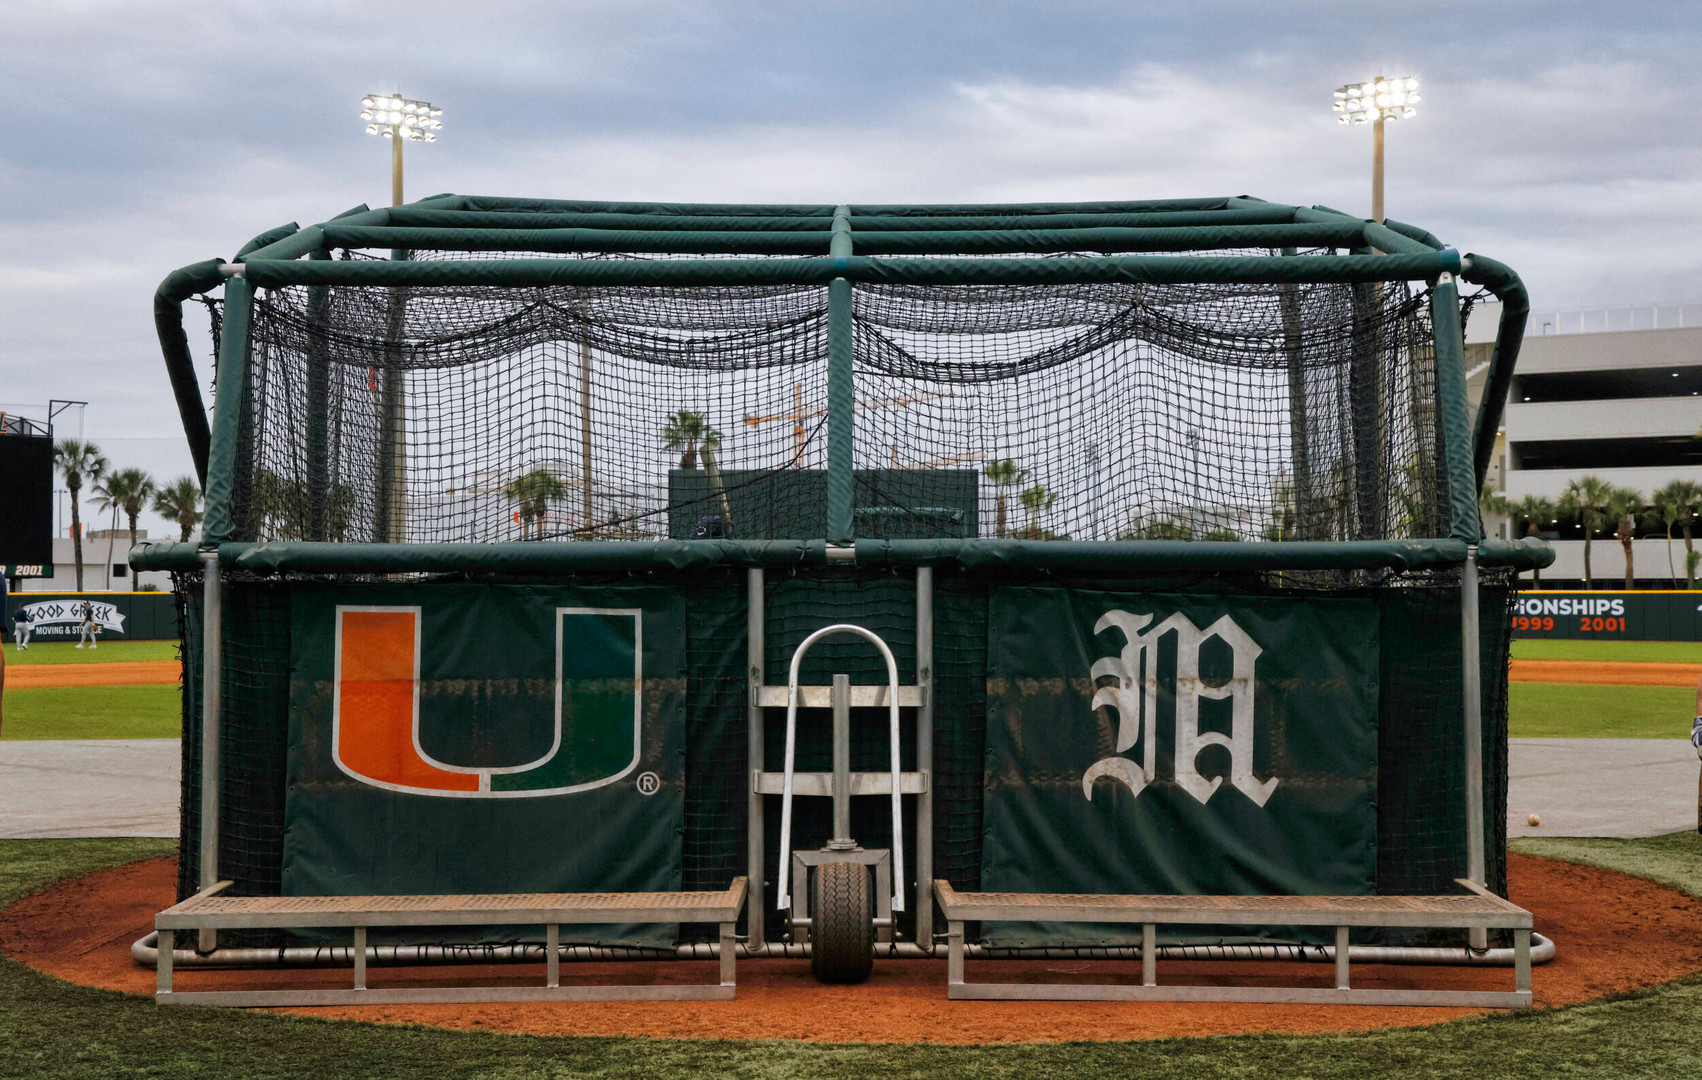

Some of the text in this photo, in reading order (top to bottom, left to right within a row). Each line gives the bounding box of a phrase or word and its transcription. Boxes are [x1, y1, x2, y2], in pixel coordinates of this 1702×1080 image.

[15, 565, 43, 576] 2001
[26, 604, 64, 620] GOOD
[70, 603, 112, 621] GREK
[36, 626, 102, 635] MOVING & STOE
[1512, 617, 1625, 632] 1999 2001
[331, 605, 643, 798] U
